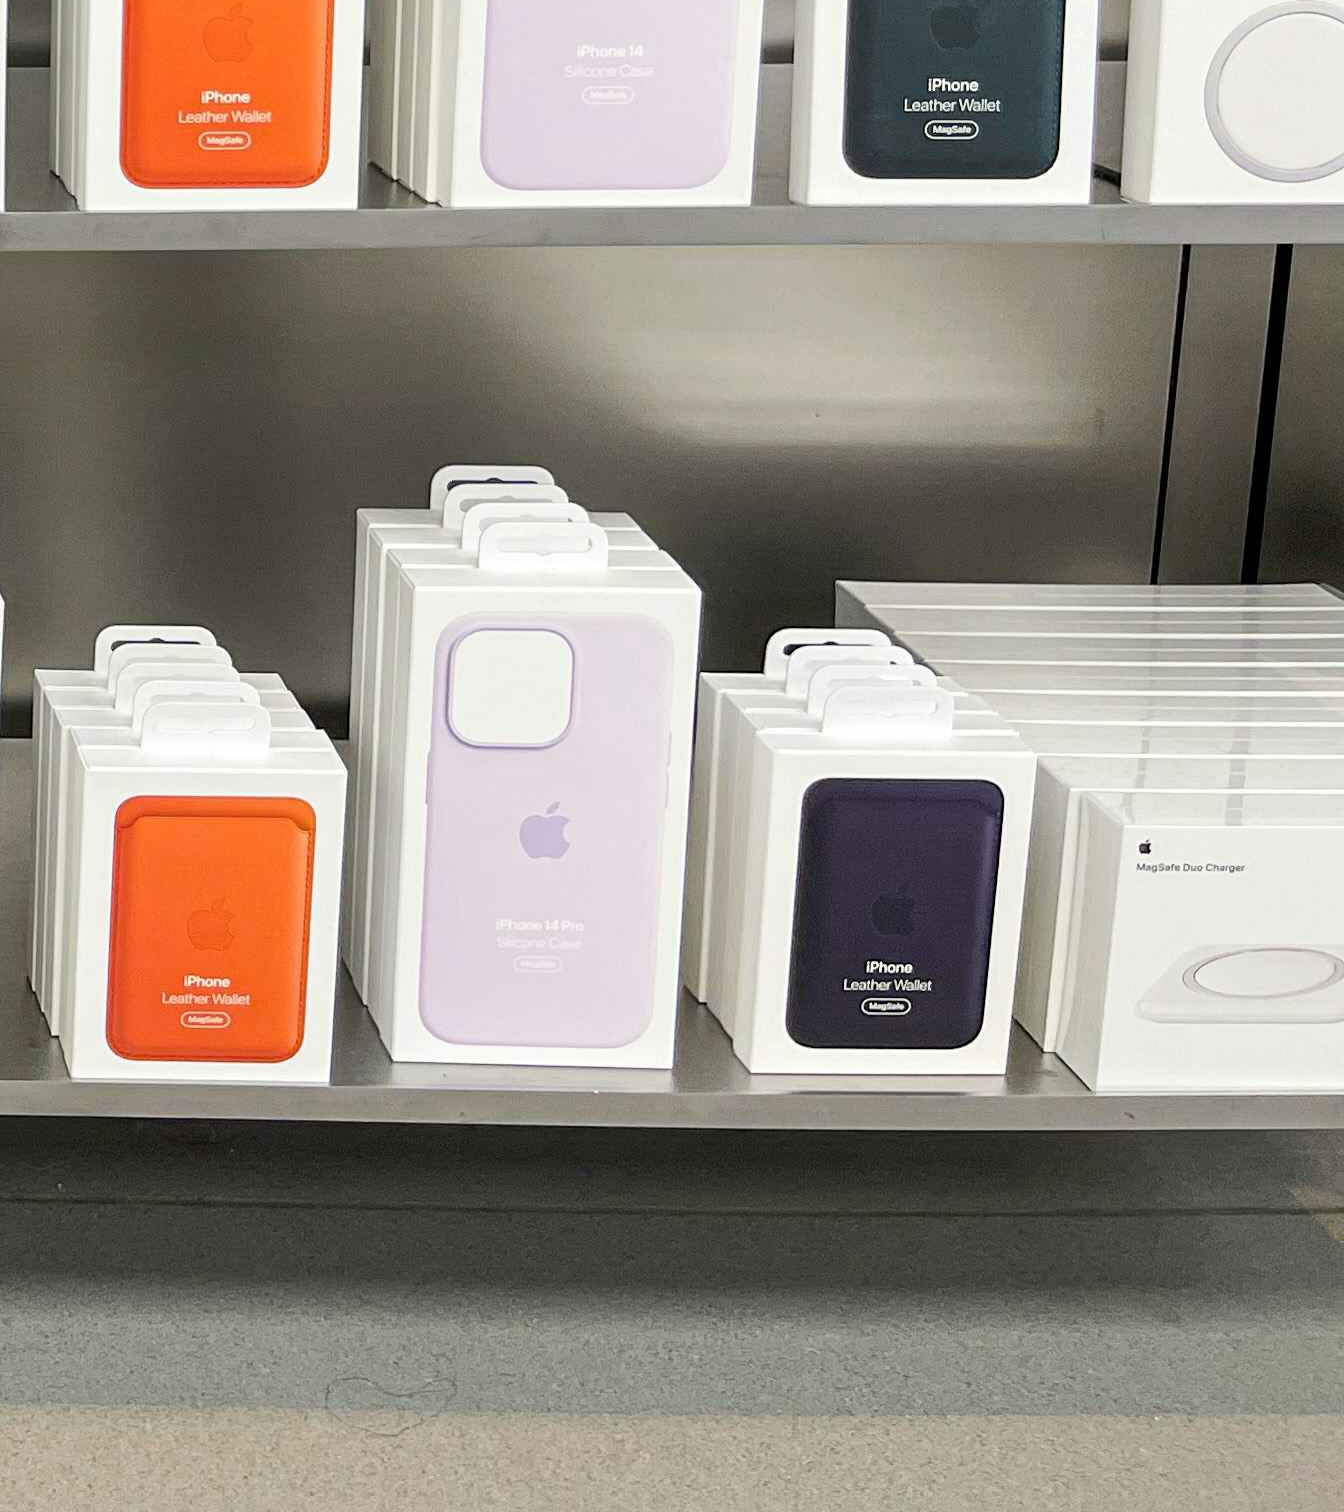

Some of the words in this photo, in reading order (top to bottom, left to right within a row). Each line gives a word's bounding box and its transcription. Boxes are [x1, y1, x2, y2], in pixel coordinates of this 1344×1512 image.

[577, 45, 625, 57] iPhone
[630, 45, 643, 56] 14
[928, 78, 978, 92] iPhone
[201, 91, 250, 103] iPhone
[904, 99, 956, 112] Leather
[959, 99, 1000, 112] Wallet
[178, 110, 228, 123] Leather
[232, 111, 272, 123] Wallet
[1136, 864, 1180, 872] MagSafe
[1206, 863, 1245, 873] Charger
[866, 961, 912, 973] iPhone
[184, 976, 230, 987] iPhone
[844, 979, 892, 991] Leather
[894, 980, 932, 991] Wallet
[162, 993, 209, 1004] Leather
[212, 993, 250, 1005] Wallet
